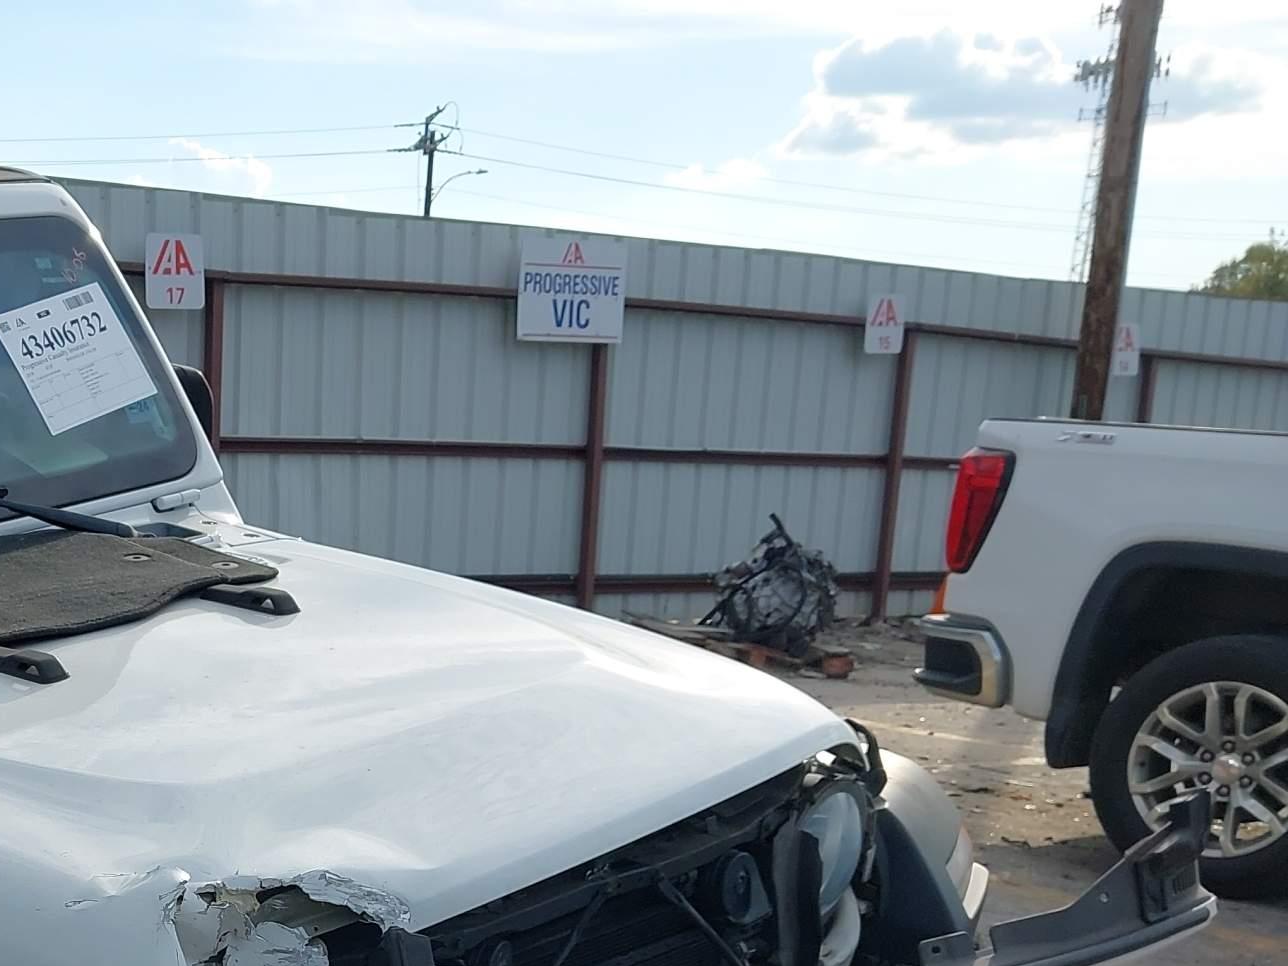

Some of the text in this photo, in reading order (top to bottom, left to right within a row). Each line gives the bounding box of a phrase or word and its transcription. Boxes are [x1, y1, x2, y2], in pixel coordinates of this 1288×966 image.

[166, 287, 185, 305] 17
[523, 272, 620, 296] PROGRESSIVE
[552, 298, 591, 329] VIC
[20, 311, 108, 359] 43406732
